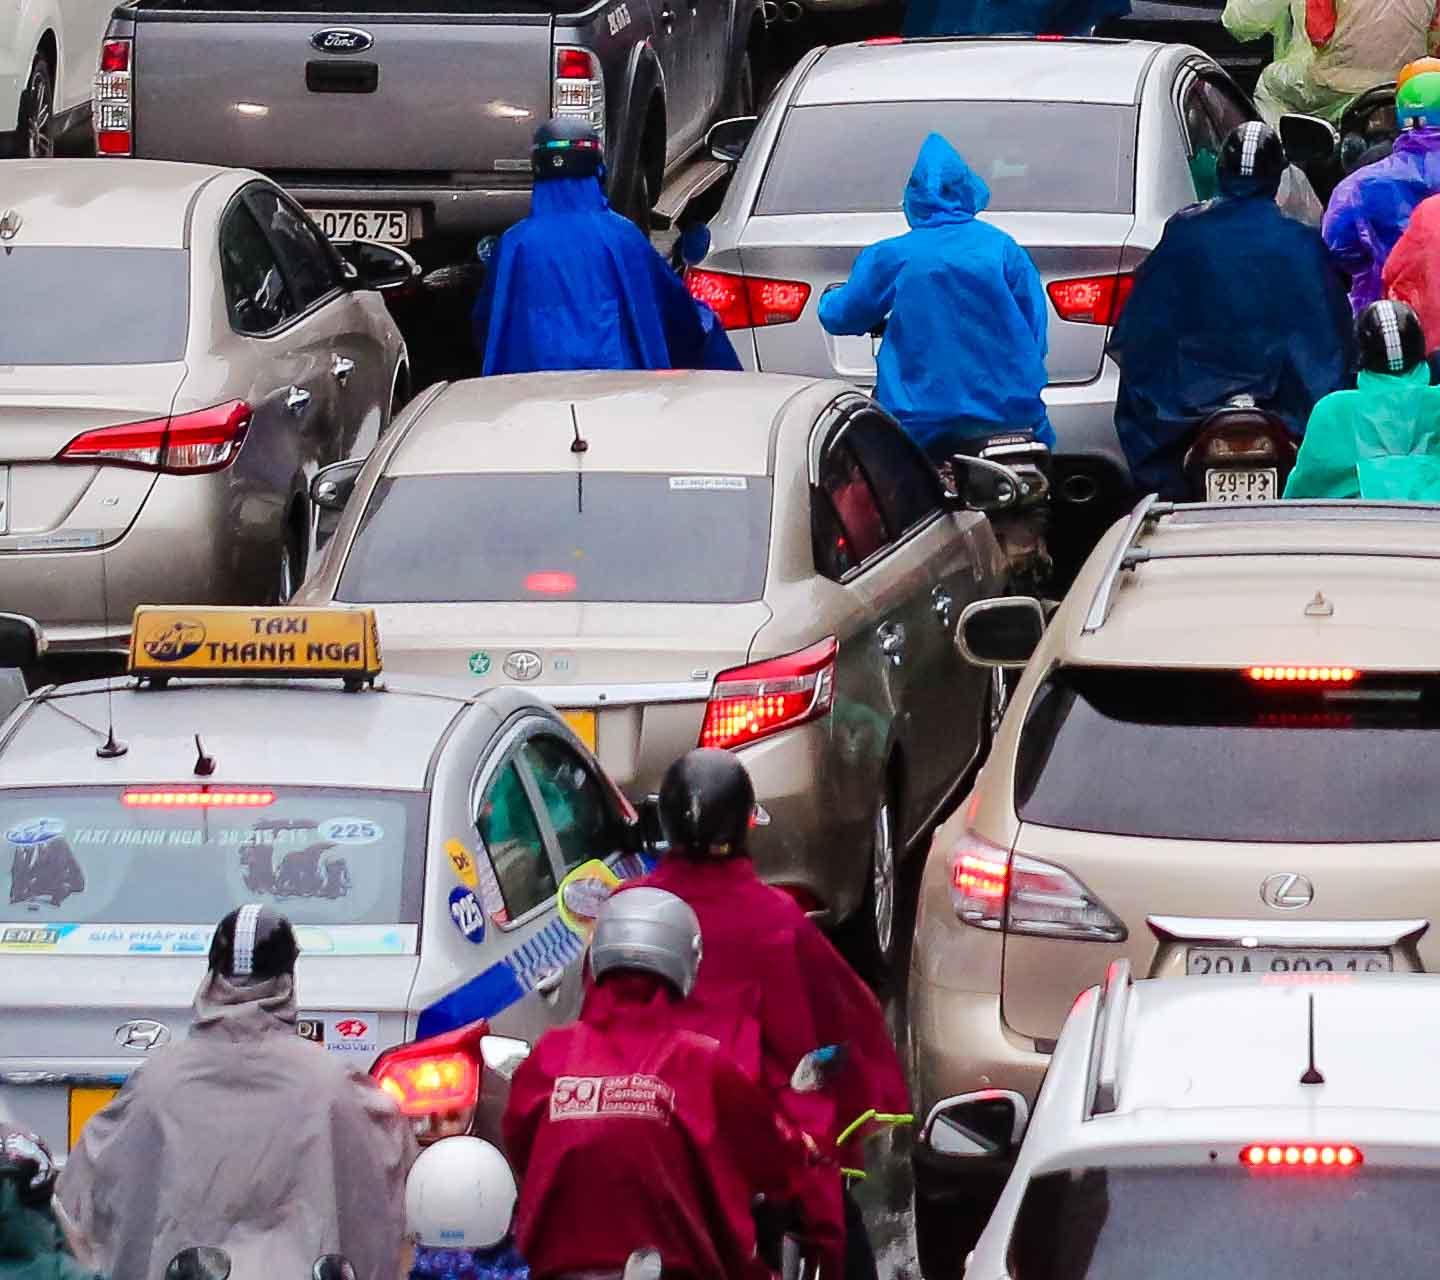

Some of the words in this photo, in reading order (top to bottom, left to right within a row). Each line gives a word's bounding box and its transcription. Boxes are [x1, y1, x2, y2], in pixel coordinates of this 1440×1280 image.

[323, 34, 358, 47] Ford
[251, 617, 308, 635] TAXI
[208, 642, 295, 663] THANH
[307, 642, 361, 662] NGA
[330, 825, 376, 838] 225
